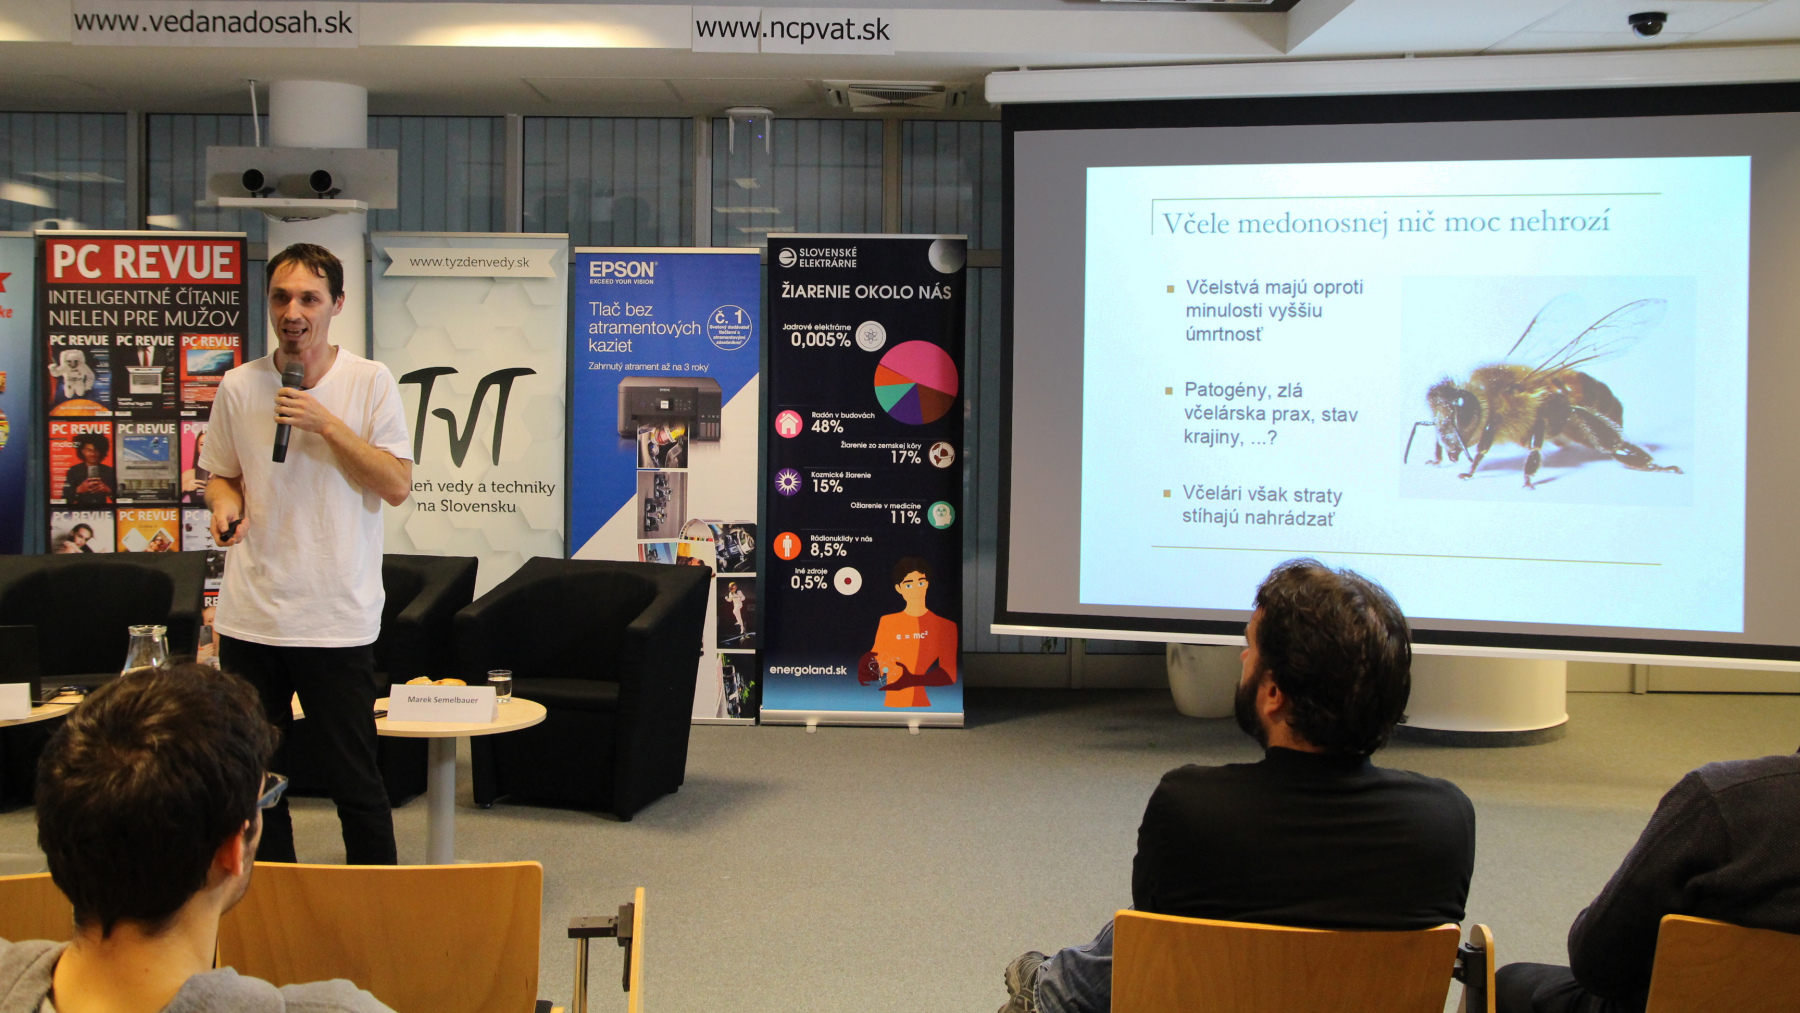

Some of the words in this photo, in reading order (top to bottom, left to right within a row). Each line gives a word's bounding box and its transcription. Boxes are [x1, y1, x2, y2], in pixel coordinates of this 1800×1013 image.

[74, 9, 353, 34] www.vedanadosah.sk
[696, 17, 890, 45] www.ncpvat.sk
[1162, 211, 1230, 235] Včele
[1238, 211, 1388, 240] medonosnej
[1398, 209, 1436, 233] nič
[1444, 216, 1501, 233] moc
[1509, 207, 1611, 232] nehrozí
[799, 246, 858, 258] SLOVENSKÉ
[53, 244, 102, 279] PC
[113, 245, 235, 280] REVUE
[409, 256, 530, 270] www.tyzdenvedy.sk
[589, 260, 654, 278] EPSON
[799, 258, 857, 268] ELEKTRÁRNE
[781, 280, 851, 299] ŽIARENIE
[854, 284, 914, 299] OKOLO
[918, 281, 952, 300] NÁS
[1186, 279, 1260, 295] Včelstvá
[1265, 279, 1308, 299] majú
[1313, 279, 1364, 299] oproti
[48, 287, 171, 305] INTELIGENTNÉ
[176, 287, 240, 306] ČÍTANIE
[48, 310, 118, 327] NIELEN
[124, 310, 159, 327] PRE
[164, 306, 240, 327] MUŽOV
[588, 302, 621, 317] Tlač
[625, 302, 653, 317] bez
[734, 309, 742, 324] 1
[1186, 302, 1263, 318] minulosti
[1268, 302, 1323, 322] vyššiu
[588, 320, 701, 338] atramentových
[782, 323, 812, 331] Jadrové
[814, 323, 852, 331] elektrárne
[1186, 325, 1264, 342] úmrtnosť
[50, 334, 66, 346] PC
[68, 334, 109, 346] REVUE
[116, 335, 133, 346] PC
[135, 335, 175, 346] REVUE
[182, 336, 198, 347] PC
[200, 336, 239, 347] REVUE
[588, 338, 633, 353] kaziet
[791, 331, 852, 349] 0,005%
[588, 362, 623, 372] Zahrnutý
[624, 362, 659, 371] atrament
[661, 362, 671, 371] až
[672, 363, 683, 371] na
[684, 362, 690, 371] 3
[1185, 381, 1272, 401] Patogény,
[1277, 382, 1303, 398] zlá
[811, 411, 834, 419] Radón
[1184, 404, 1266, 421] včelárska
[1272, 408, 1315, 425] prax,
[1321, 407, 1359, 422] stav
[51, 423, 68, 435] PC
[70, 423, 111, 435] REVUE
[117, 423, 134, 434] PC
[136, 423, 176, 434] REVUE
[183, 423, 199, 434] PC
[811, 420, 844, 433] 48%
[840, 440, 867, 449] Žiarenie
[878, 442, 906, 450] zemskej
[906, 442, 922, 450] kôry
[1184, 429, 1244, 448] krajiny,
[1251, 429, 1278, 445] ...?
[891, 450, 922, 464] 17%
[811, 471, 844, 479] Kozmické
[437, 481, 473, 495] vedy
[478, 482, 487, 492] a
[491, 481, 556, 497] techniky
[812, 479, 844, 493] 15%
[1183, 484, 1242, 501] Včelári
[1248, 485, 1288, 502] však
[1293, 488, 1343, 507] straty
[417, 501, 436, 512] na
[440, 499, 516, 513] Slovensku
[52, 511, 69, 521] PC
[71, 511, 112, 521] REVUE
[119, 510, 135, 521] PC
[138, 510, 177, 521] REVUE
[184, 511, 200, 521] PC
[890, 510, 922, 525] 11%
[1182, 508, 1239, 528] stíhajú
[1245, 509, 1336, 527] nahrádzať
[810, 535, 853, 543] Rádionuklidy
[810, 542, 847, 558] 8,5%
[807, 567, 828, 575] zdroje
[791, 575, 828, 590] 0,5%
[769, 665, 848, 677] energoland.sk
[407, 695, 432, 703] Marek
[433, 696, 479, 704] Semelbauer
